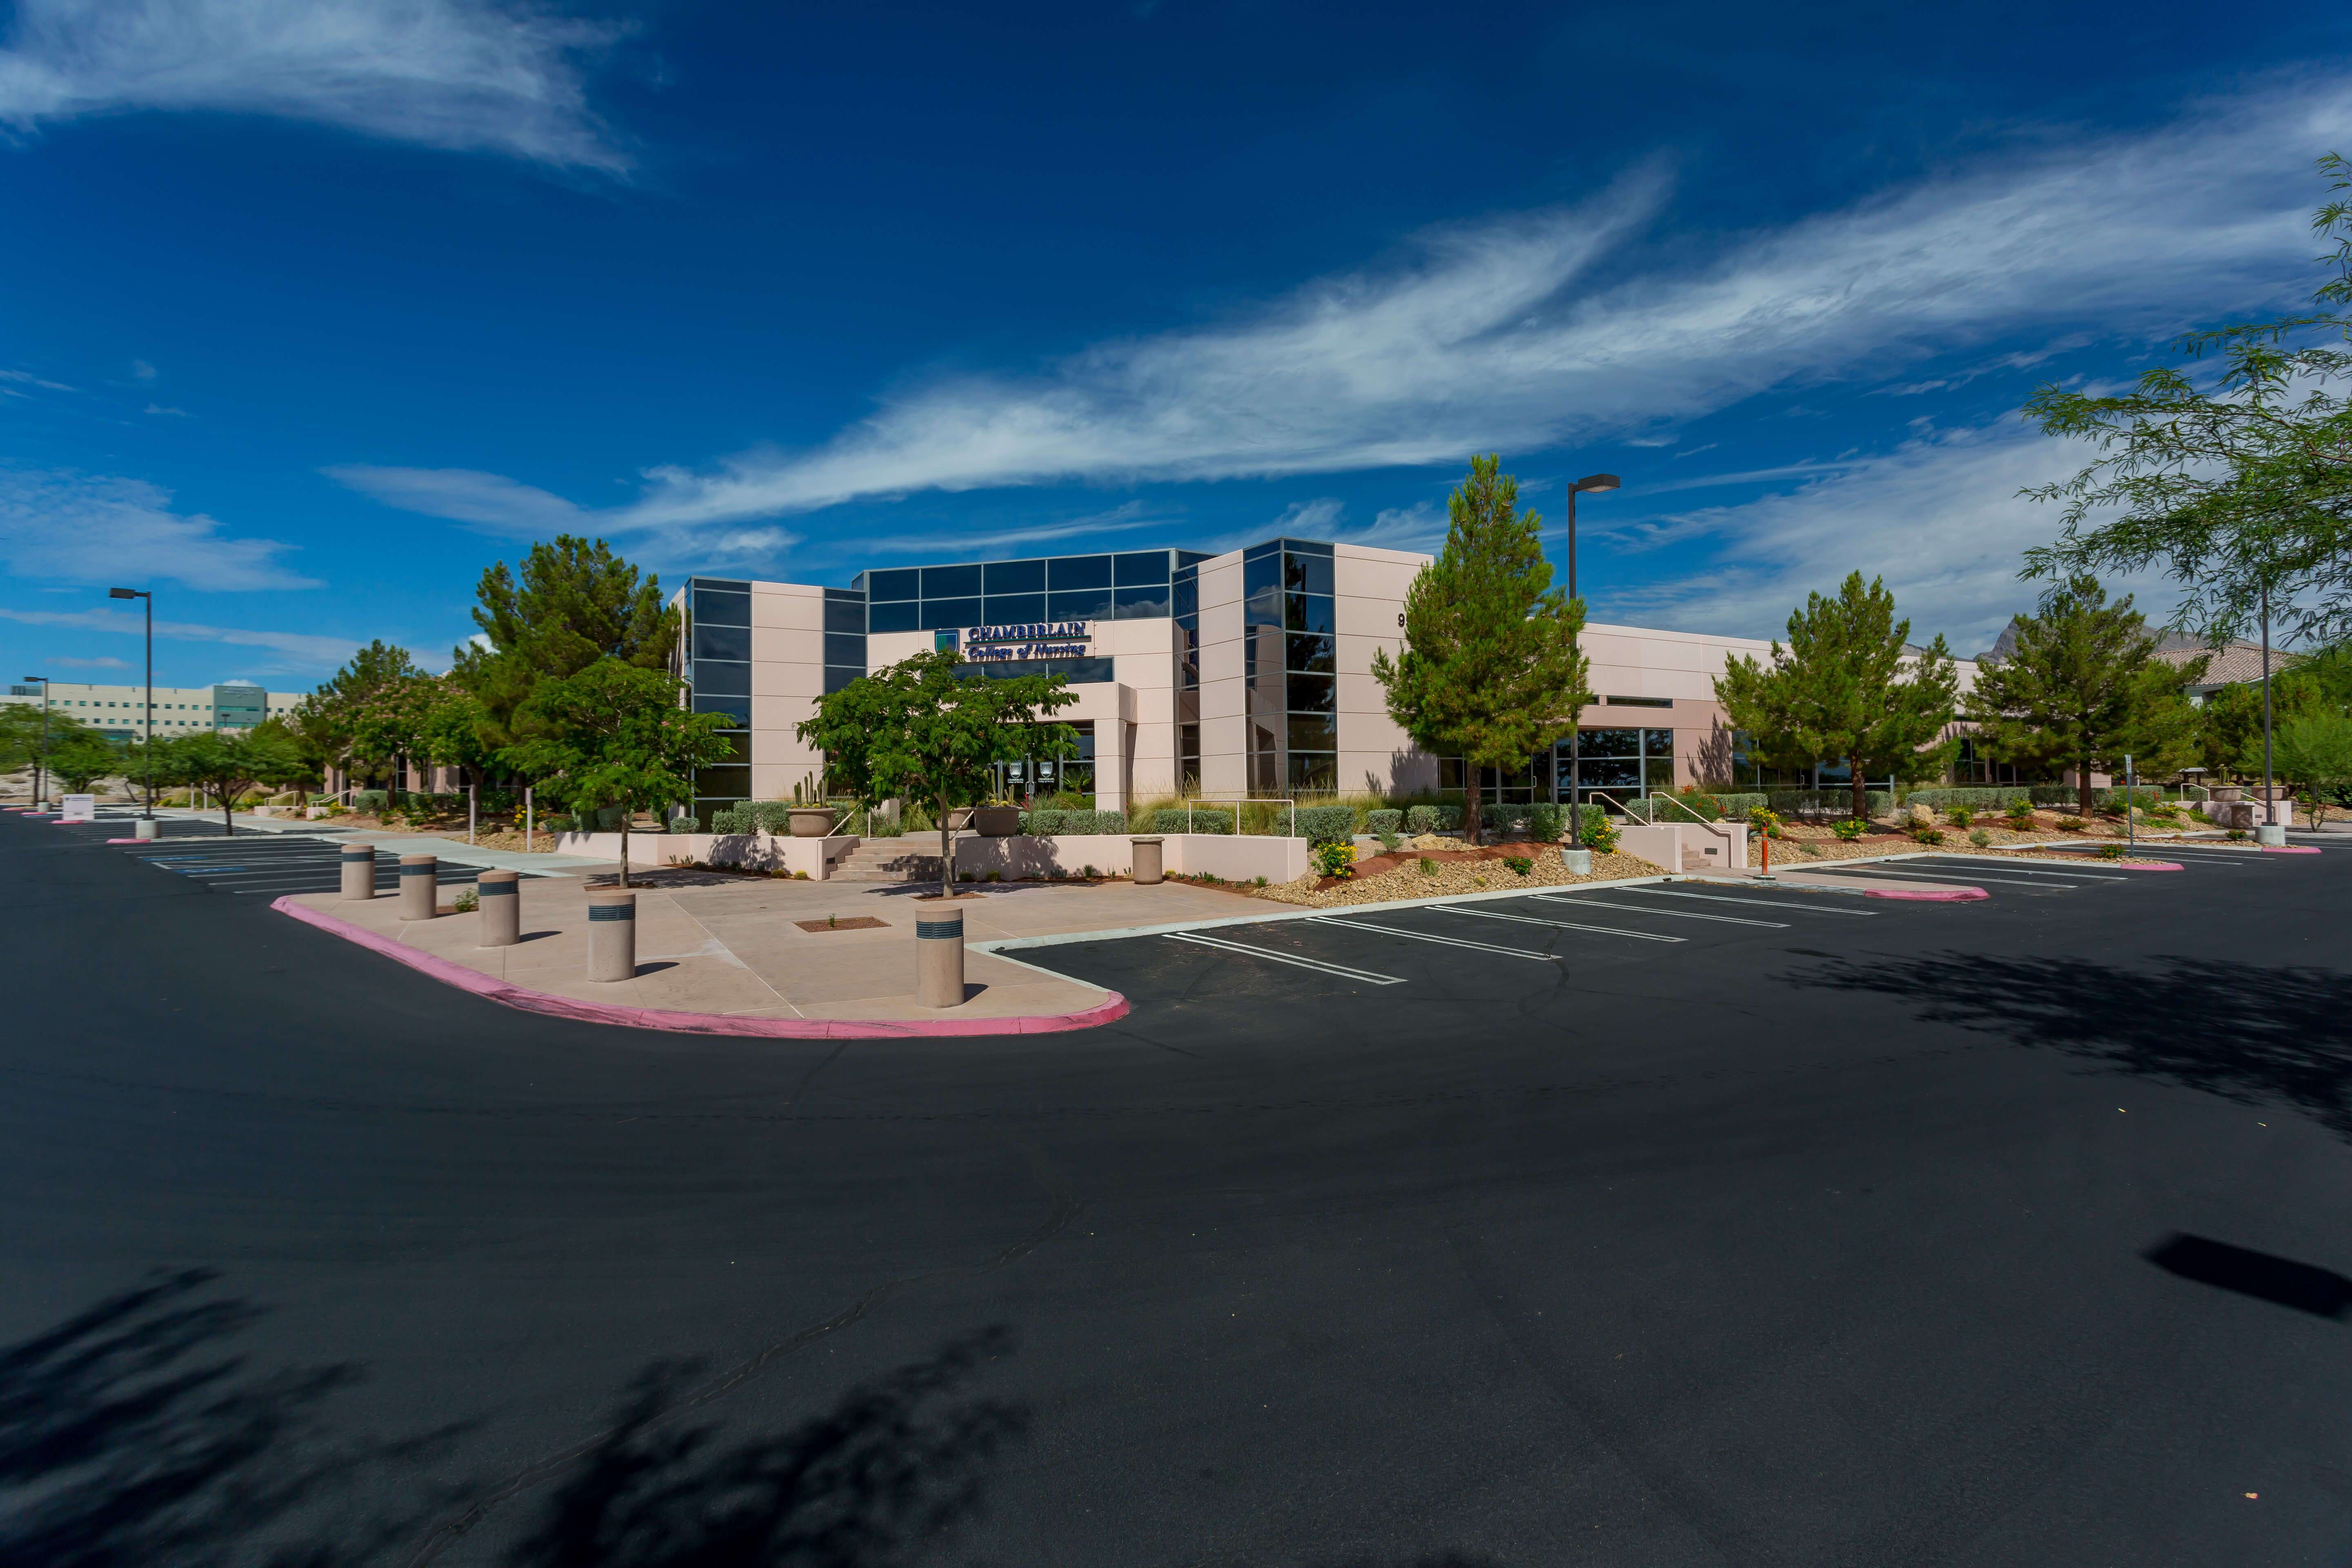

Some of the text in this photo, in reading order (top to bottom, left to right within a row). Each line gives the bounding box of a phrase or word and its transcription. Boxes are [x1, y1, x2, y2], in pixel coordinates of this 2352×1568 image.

[968, 622, 1085, 639] CHAMBERLAIN
[968, 641, 1085, 659] College of Nursing
